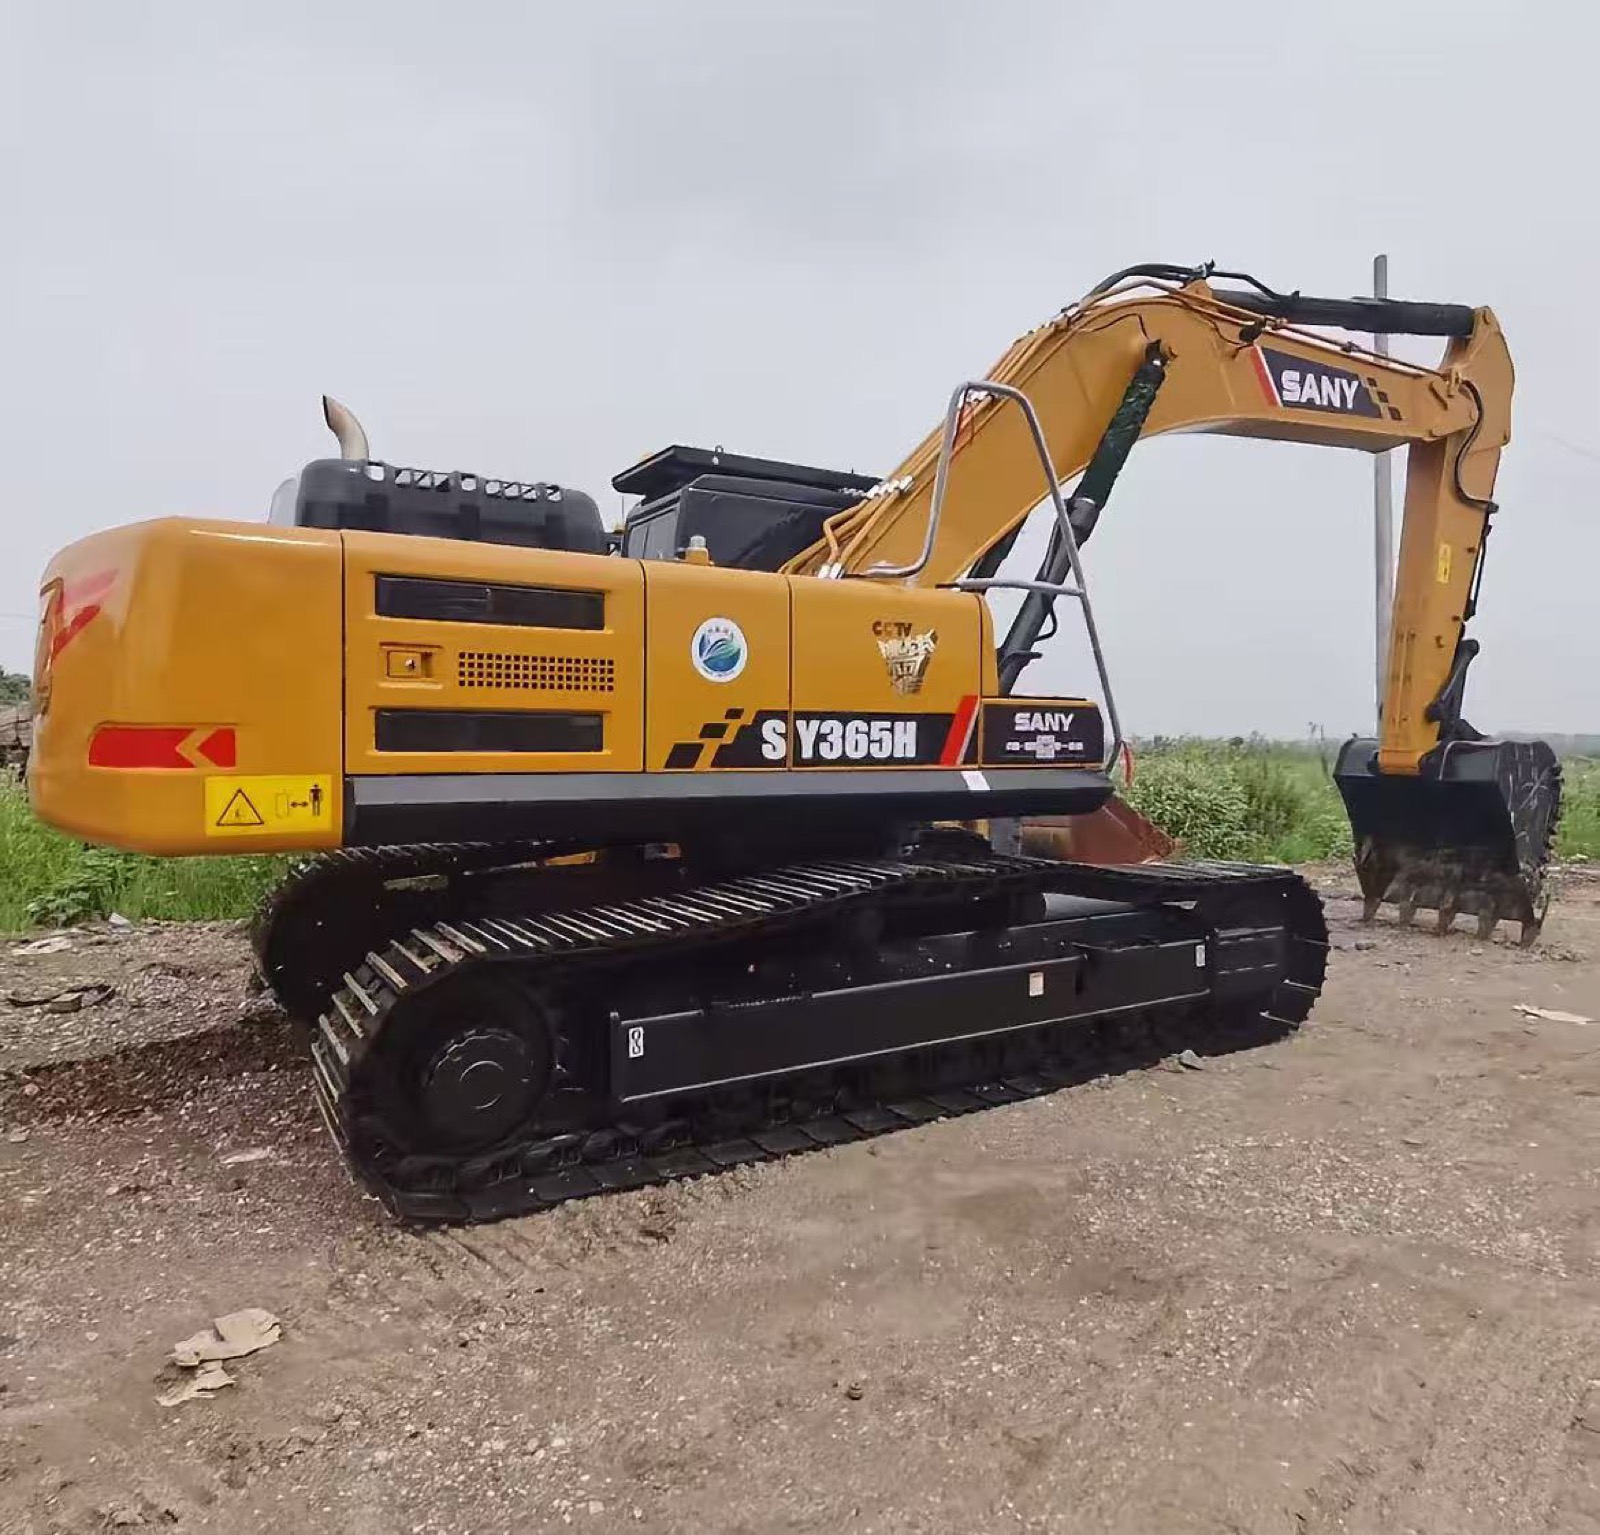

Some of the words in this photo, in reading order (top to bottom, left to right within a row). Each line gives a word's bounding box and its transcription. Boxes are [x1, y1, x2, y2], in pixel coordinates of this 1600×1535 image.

[1281, 369, 1359, 409] SANY
[761, 719, 917, 760] SY365H
[1014, 712, 1075, 732] SANY
